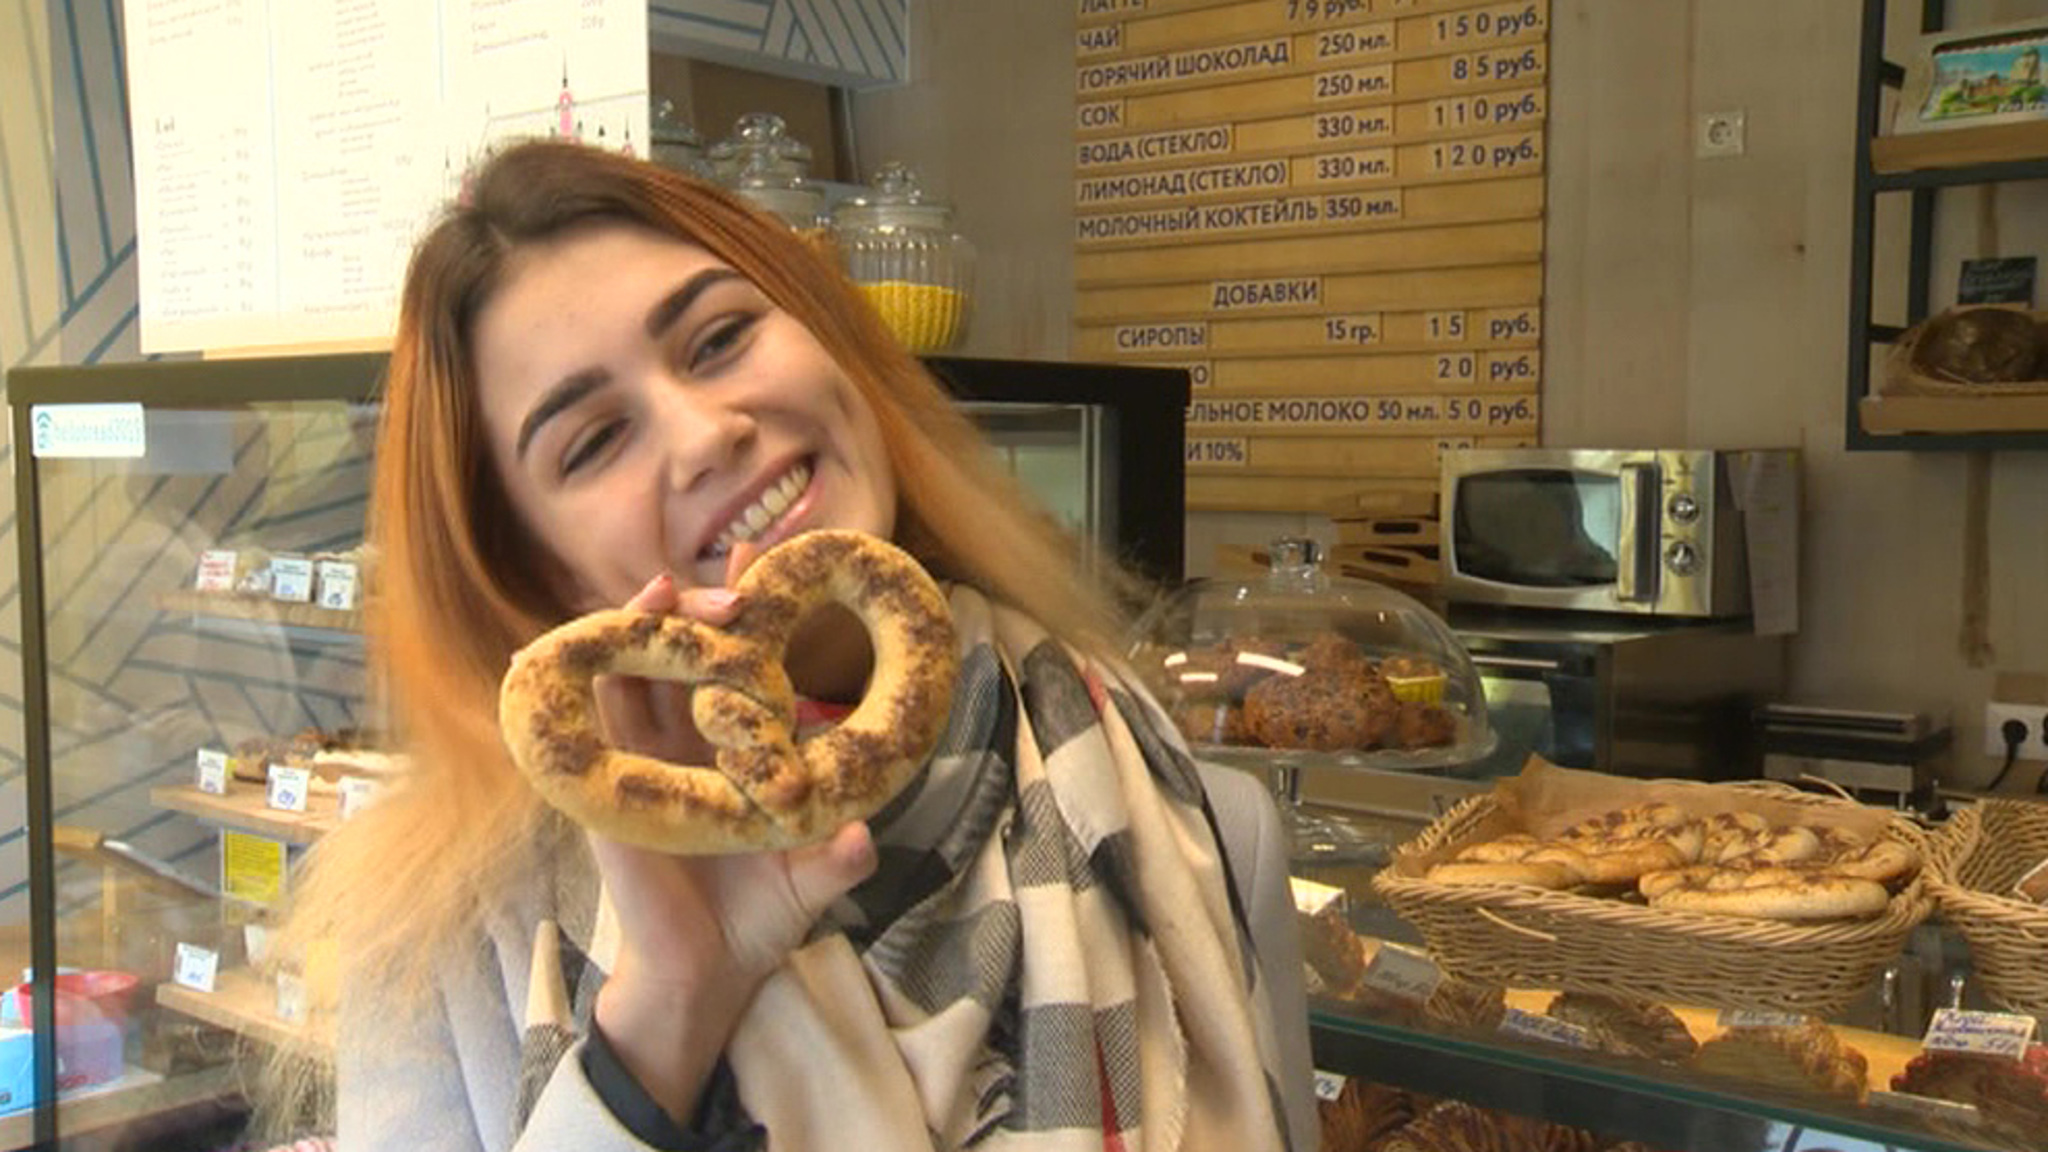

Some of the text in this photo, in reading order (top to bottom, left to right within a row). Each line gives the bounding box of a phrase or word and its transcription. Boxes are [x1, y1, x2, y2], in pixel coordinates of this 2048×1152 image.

[1080, 27, 1120, 49] ЧАЙ
[1080, 54, 1170, 89] ГОРЯЧИЙ
[1177, 42, 1288, 76] ШОКОЛАД
[1319, 32, 1354, 56] 250
[1359, 34, 1391, 51] мл.
[1496, 8, 1544, 37] руб.
[1080, 105, 1120, 126] СОК
[1318, 74, 1353, 98] 250
[1359, 76, 1389, 93] мл.
[1495, 51, 1542, 80] руб.
[1080, 140, 1133, 165] ВОДА
[1137, 129, 1229, 159] (СТЕКЛО)
[1318, 117, 1353, 138] 330
[1358, 118, 1389, 135] мл.
[1494, 95, 1541, 124] руб.
[1080, 172, 1188, 201] ЛИМОНАД
[1190, 161, 1287, 193] (СТЕКЛО)
[1318, 157, 1353, 180] 330
[1359, 159, 1389, 176] мл.
[1493, 139, 1539, 169] руб.
[1080, 197, 1398, 239] МОЛОЧНЫЙ КОКТЕЙЛЬ 350 мл.
[1212, 281, 1318, 307] ДОБАВКИ
[1117, 325, 1206, 348] СИРОПЫ
[1326, 319, 1346, 340] 15
[1350, 323, 1376, 344] гр.
[1490, 311, 1536, 338] руб.
[1490, 356, 1535, 381] руб.
[1268, 400, 1369, 422] МОЛОКО
[1376, 400, 1401, 420] 50
[1489, 400, 1534, 426] руб.
[1206, 442, 1243, 463] 10%
